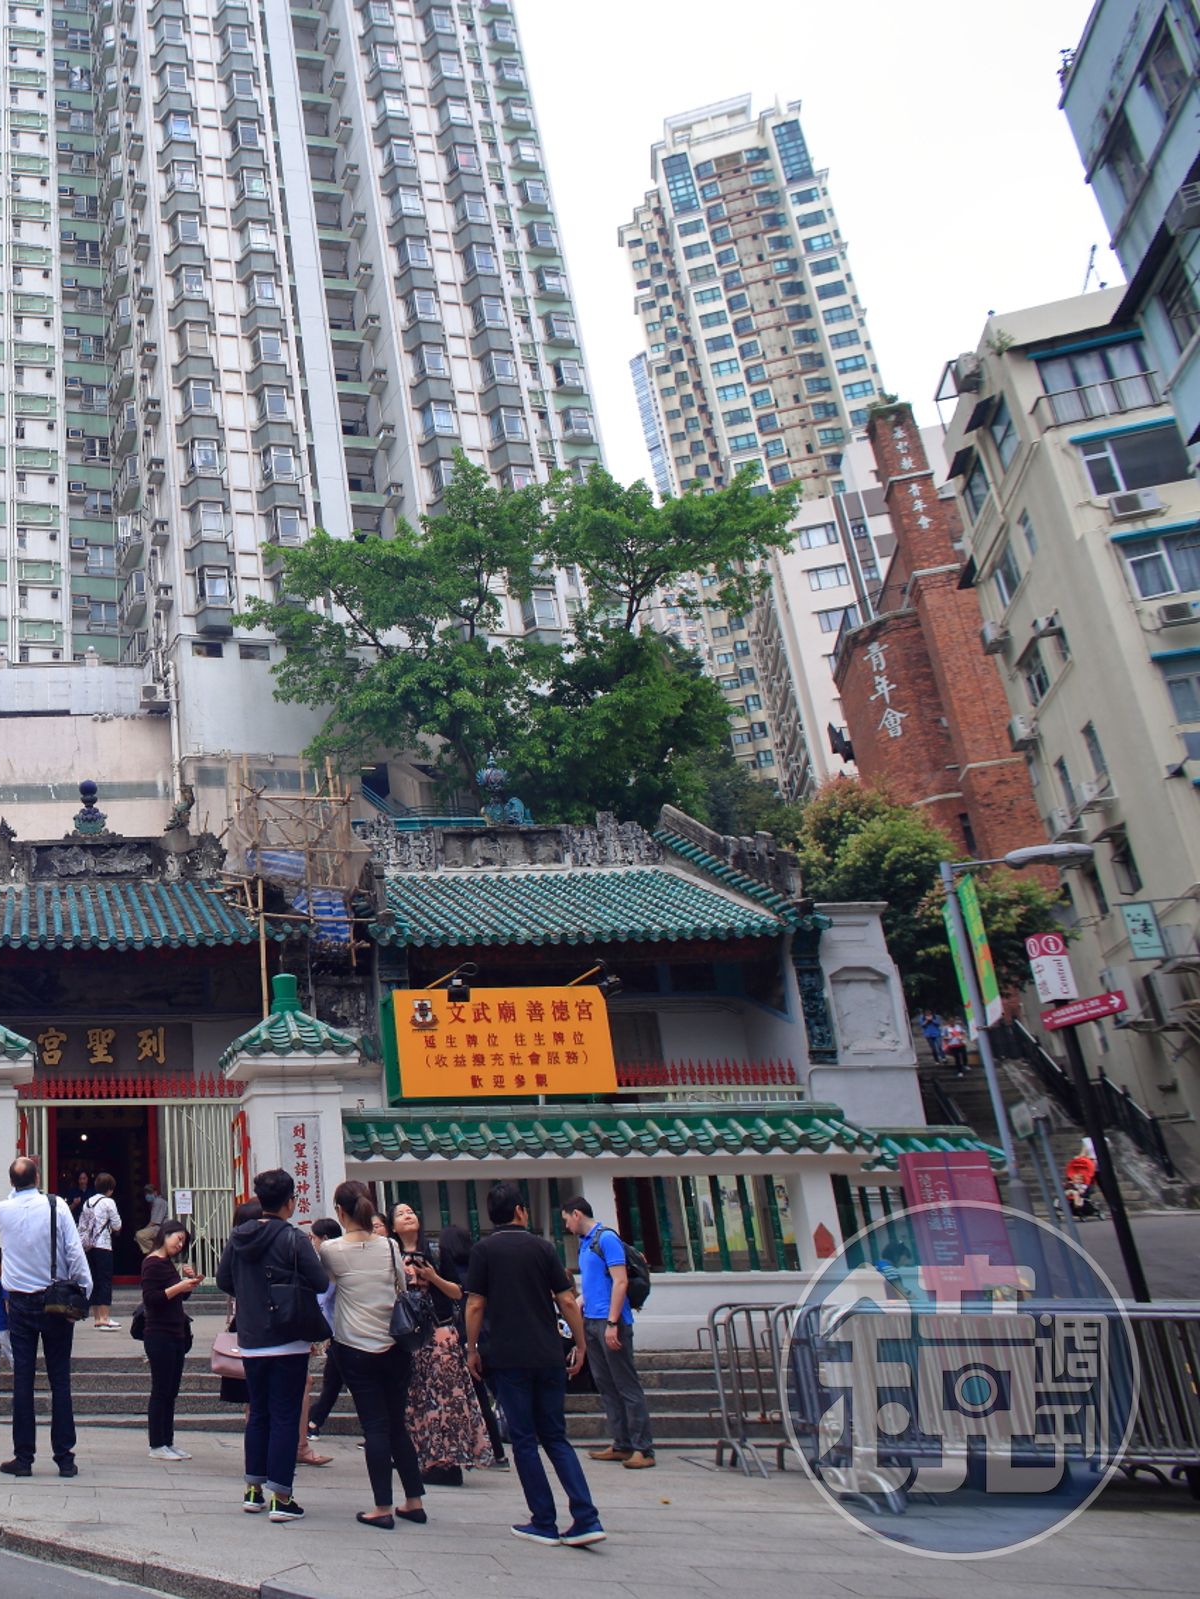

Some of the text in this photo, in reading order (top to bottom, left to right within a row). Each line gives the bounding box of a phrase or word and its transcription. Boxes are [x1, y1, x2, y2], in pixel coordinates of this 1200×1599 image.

[862, 641, 910, 738] 青年會
[1052, 959, 1070, 995] Central
[445, 999, 594, 1025] 文武廟善德宮
[470, 1073, 549, 1090] 歡迎參觀
